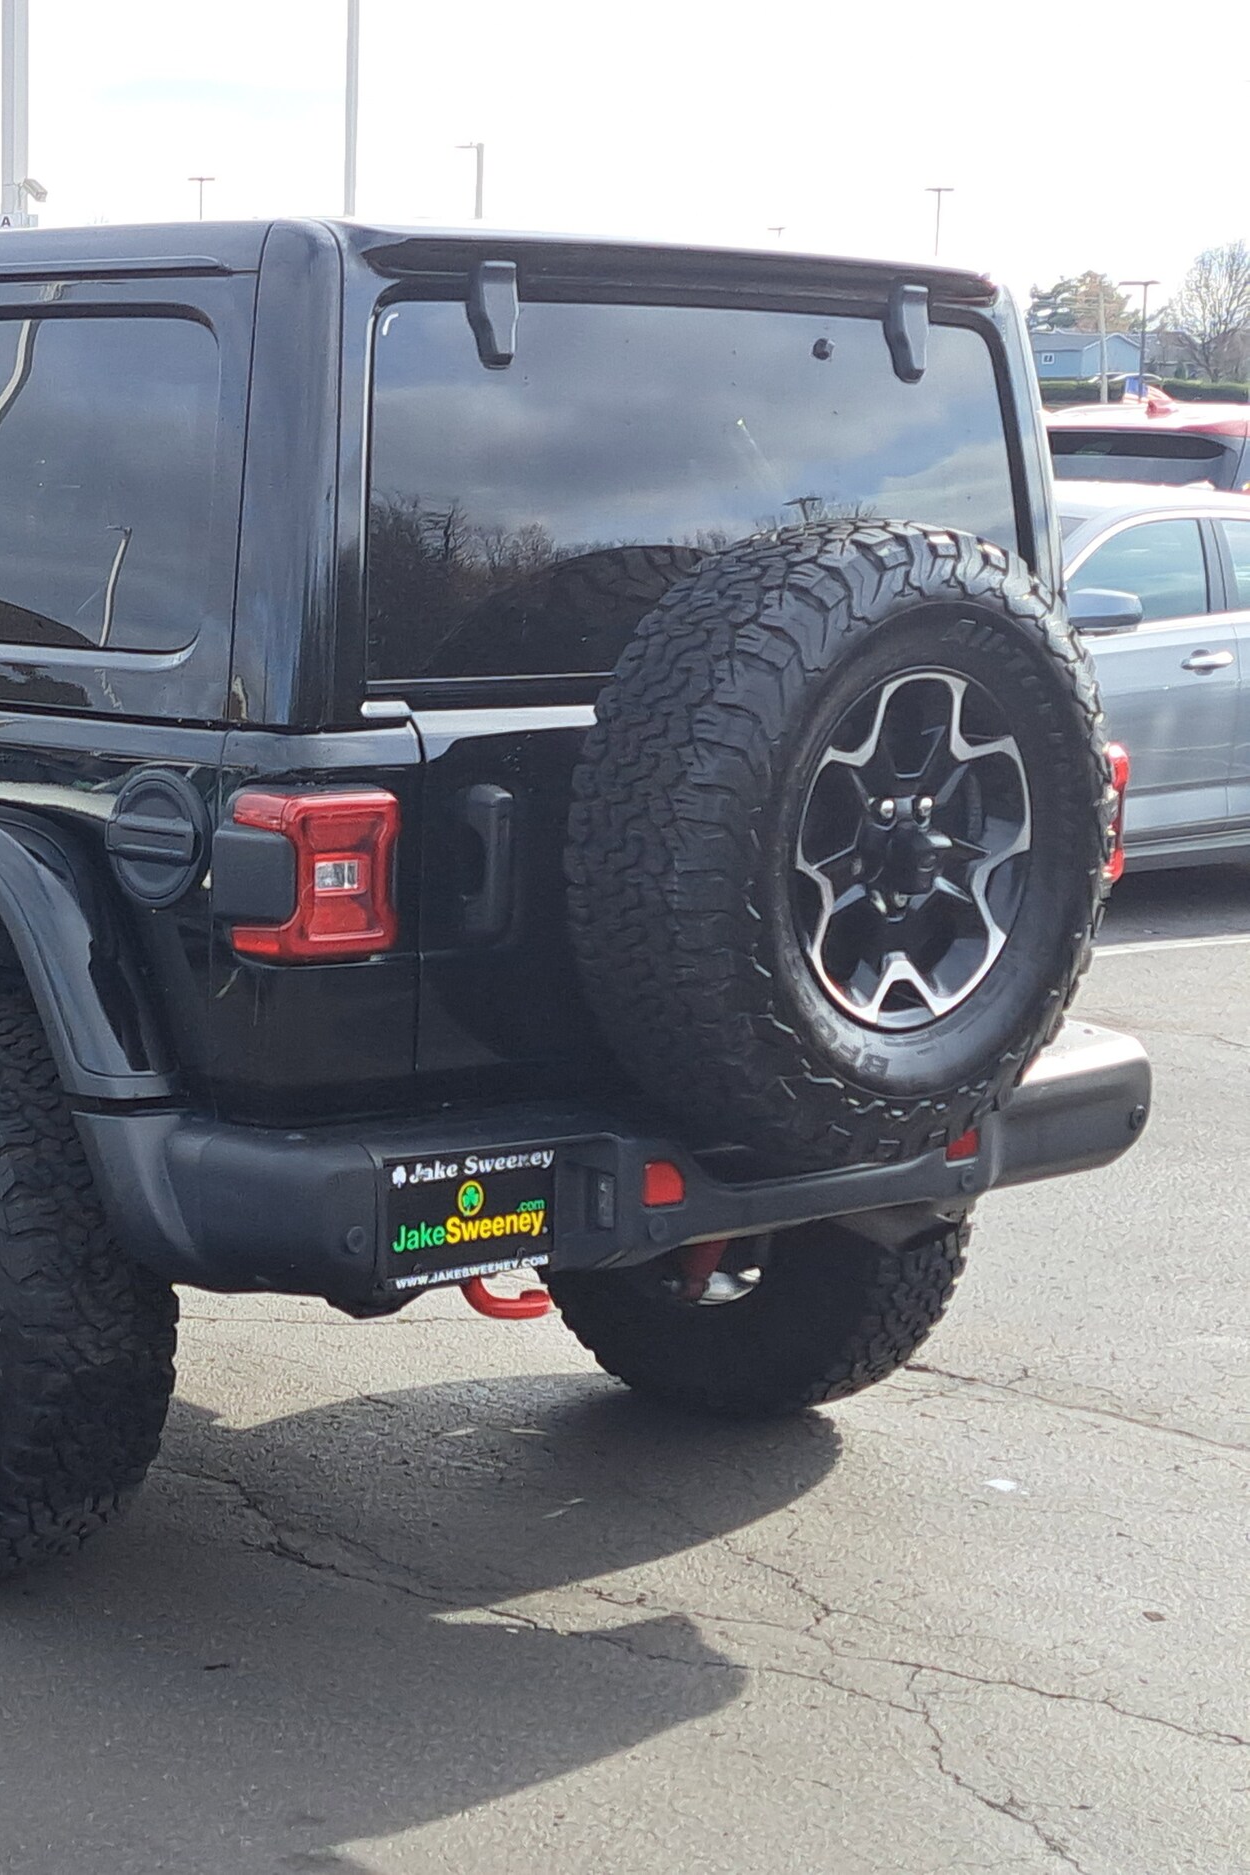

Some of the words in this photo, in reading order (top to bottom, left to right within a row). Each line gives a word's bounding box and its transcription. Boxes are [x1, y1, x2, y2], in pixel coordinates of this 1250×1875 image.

[0, 216, 11, 228] A
[409, 1160, 459, 1184] Jake
[395, 1254, 550, 1290] WWW.JAKESWEENEY.COM
